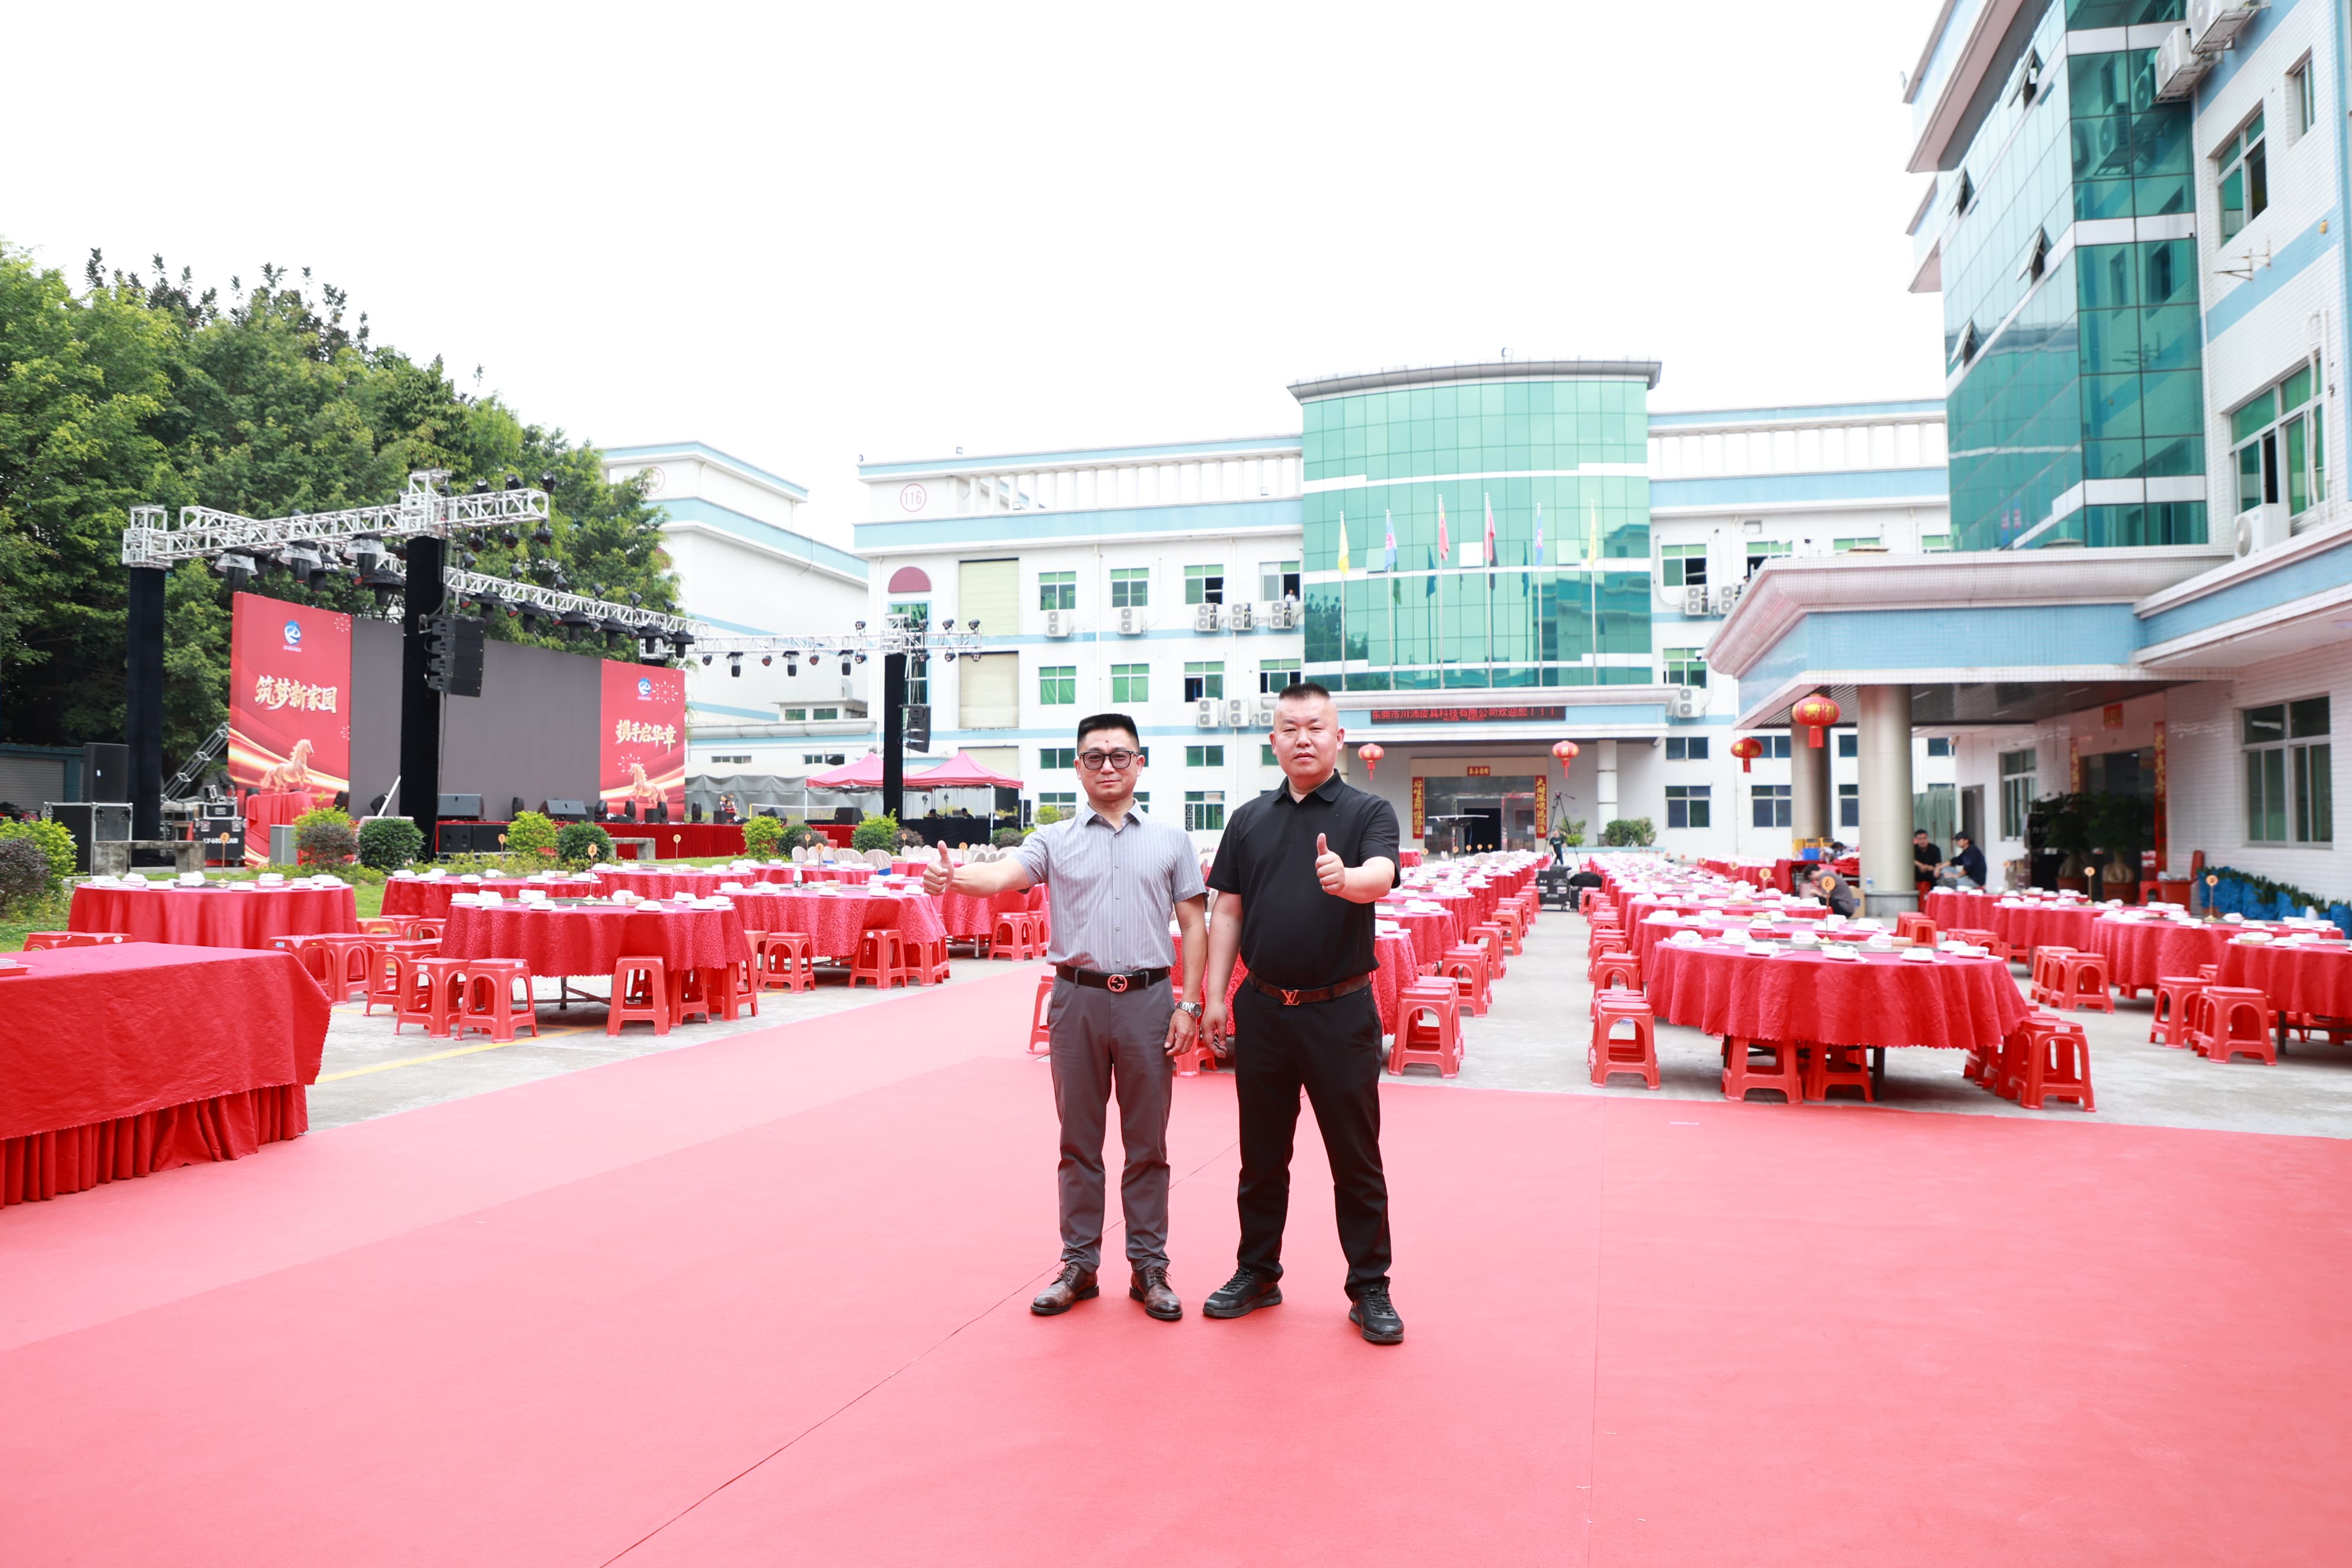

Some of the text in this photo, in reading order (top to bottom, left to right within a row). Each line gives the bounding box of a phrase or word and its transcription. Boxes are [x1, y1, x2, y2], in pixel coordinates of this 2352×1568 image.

[904, 491, 922, 505] 116
[254, 675, 338, 714] 筑梦新家园
[615, 719, 677, 755] 携手启华章
